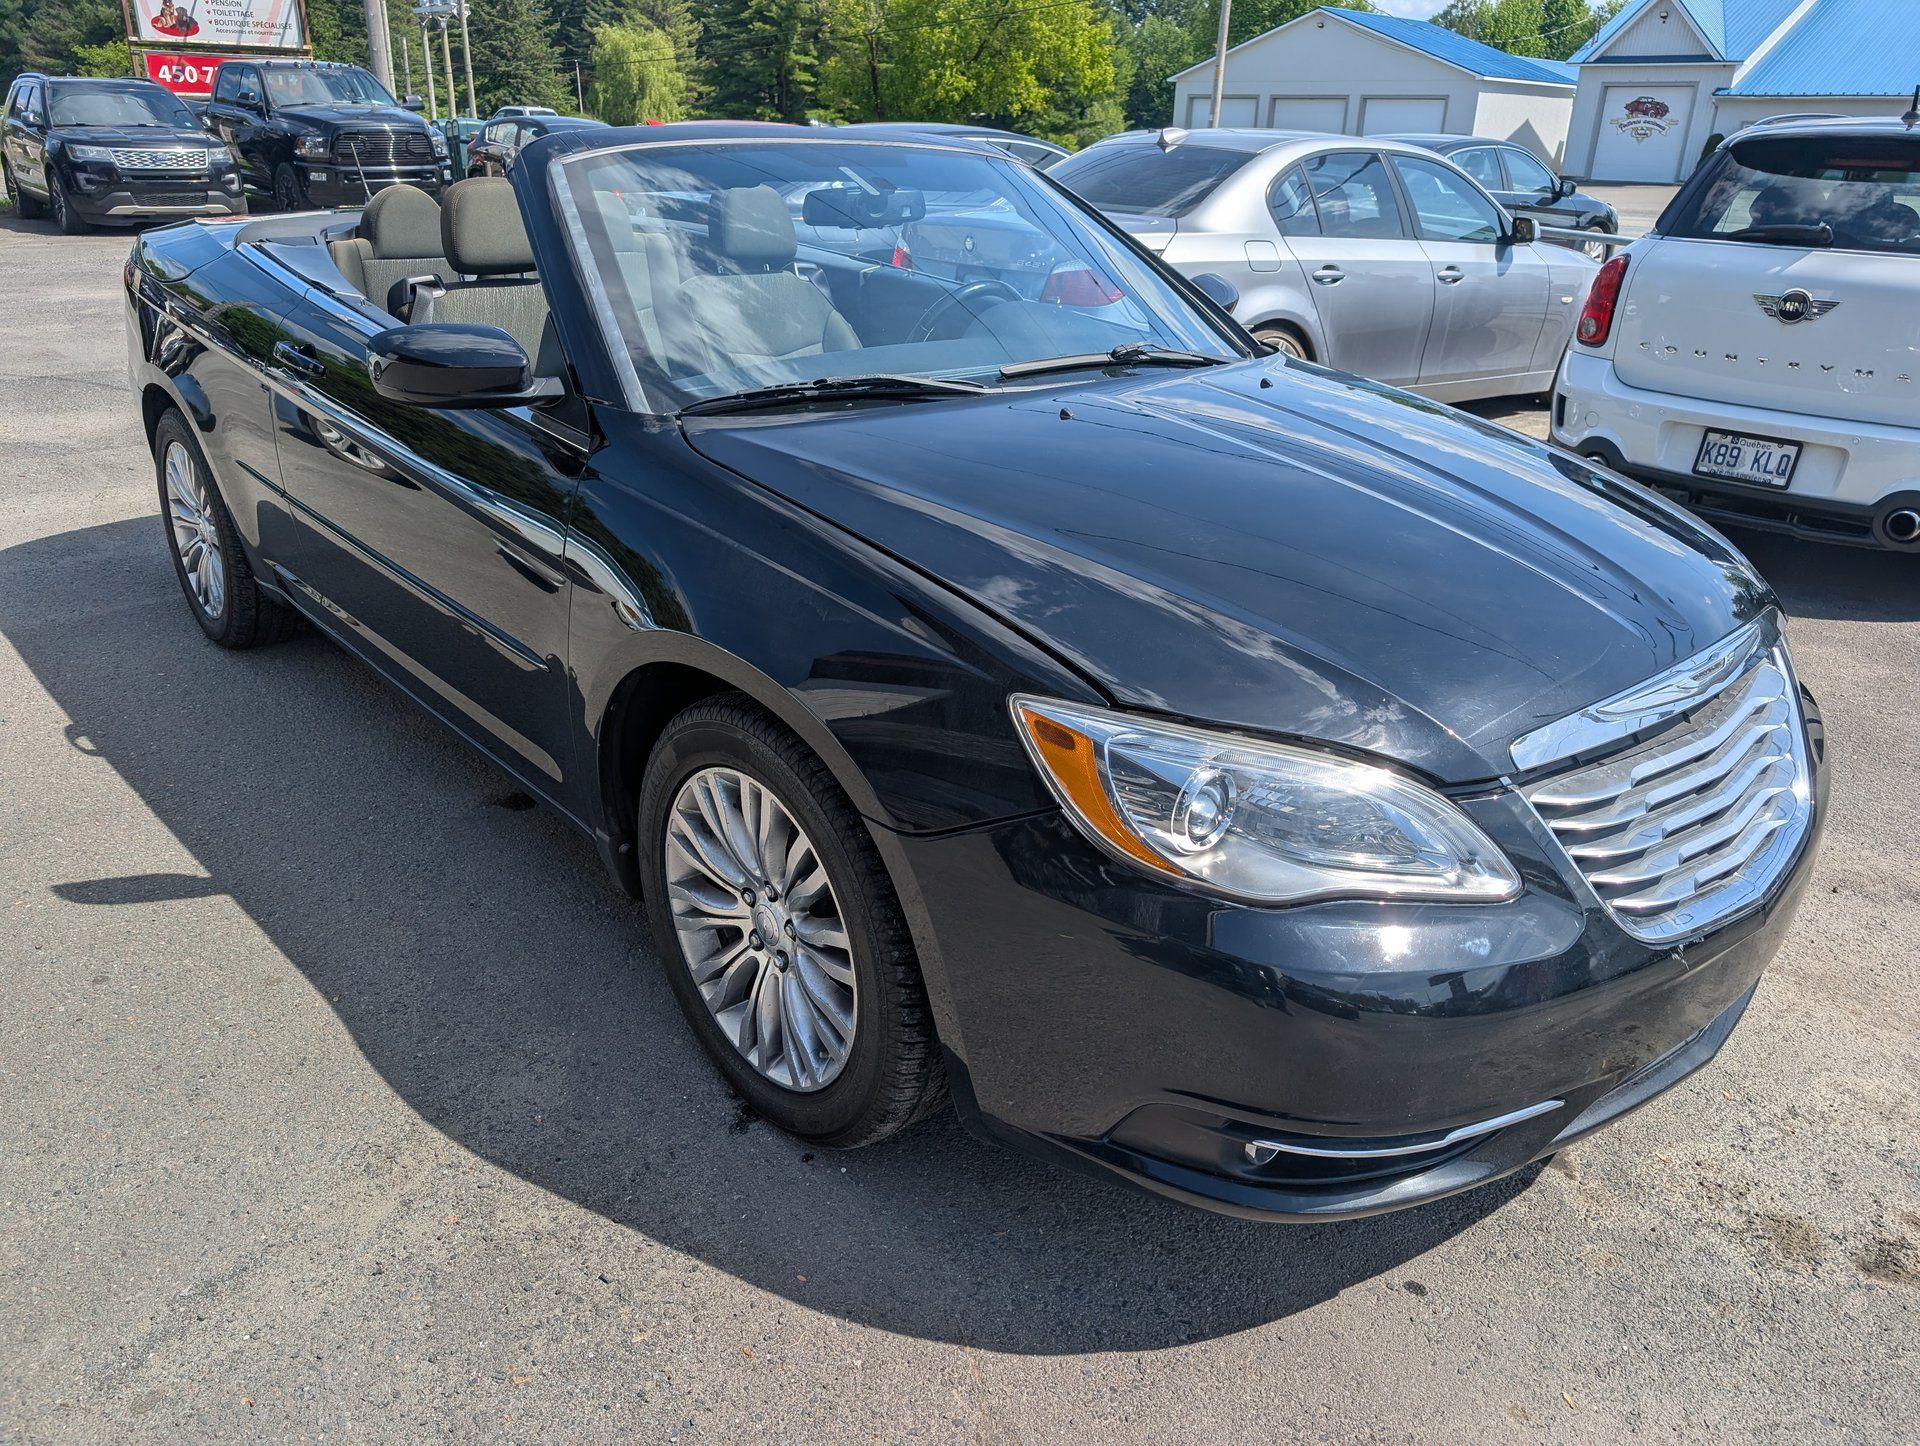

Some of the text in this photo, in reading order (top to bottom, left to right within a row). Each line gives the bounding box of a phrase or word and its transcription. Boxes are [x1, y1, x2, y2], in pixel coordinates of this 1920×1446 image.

[212, 9, 254, 18] TOILETTAGE
[214, 19, 250, 28] BOUTIQUE
[158, 65, 219, 84] 450 7
[1780, 301, 1807, 313] MINI
[1739, 439, 1772, 450] Québec
[1700, 441, 1792, 476] K89 KLQ
